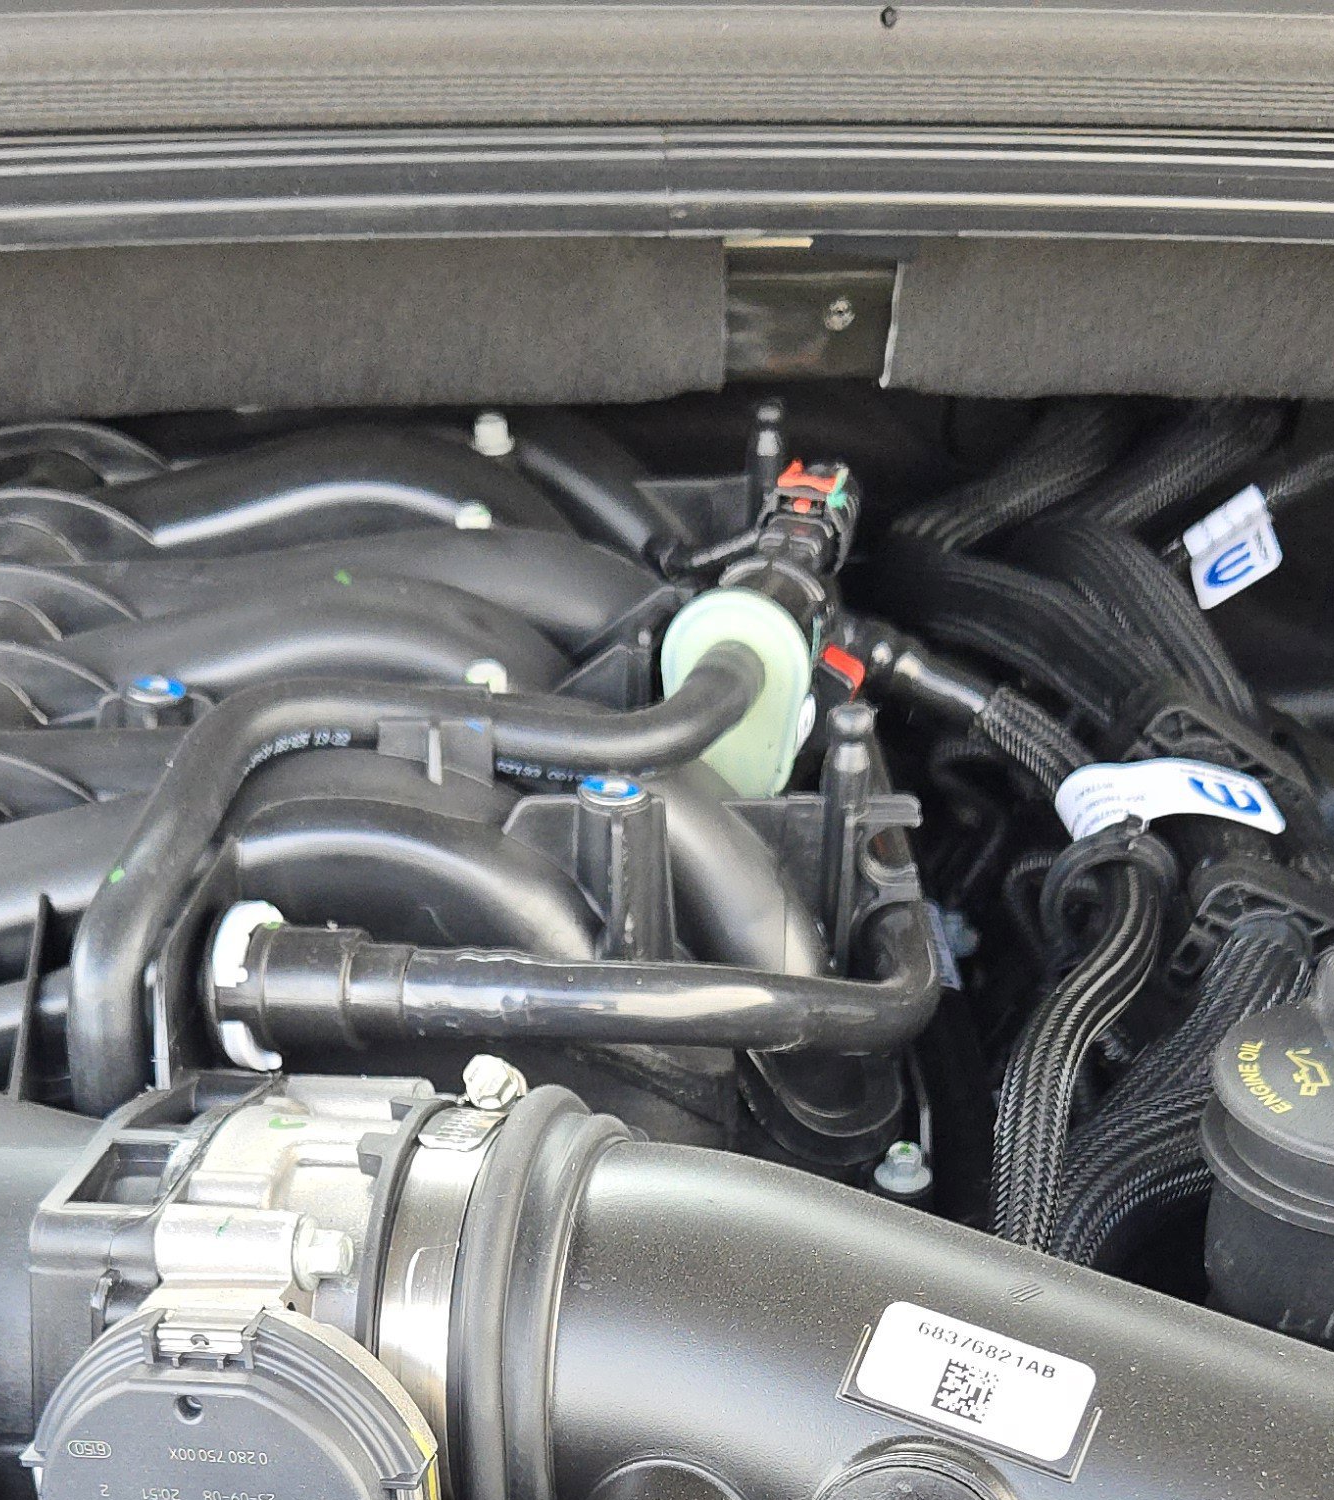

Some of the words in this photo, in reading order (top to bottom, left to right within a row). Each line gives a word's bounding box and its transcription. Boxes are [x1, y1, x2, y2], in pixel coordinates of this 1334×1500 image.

[1237, 1039, 1264, 1062] OIL
[1238, 1064, 1294, 1114] ENGINE
[99, 1484, 110, 1497] 2
